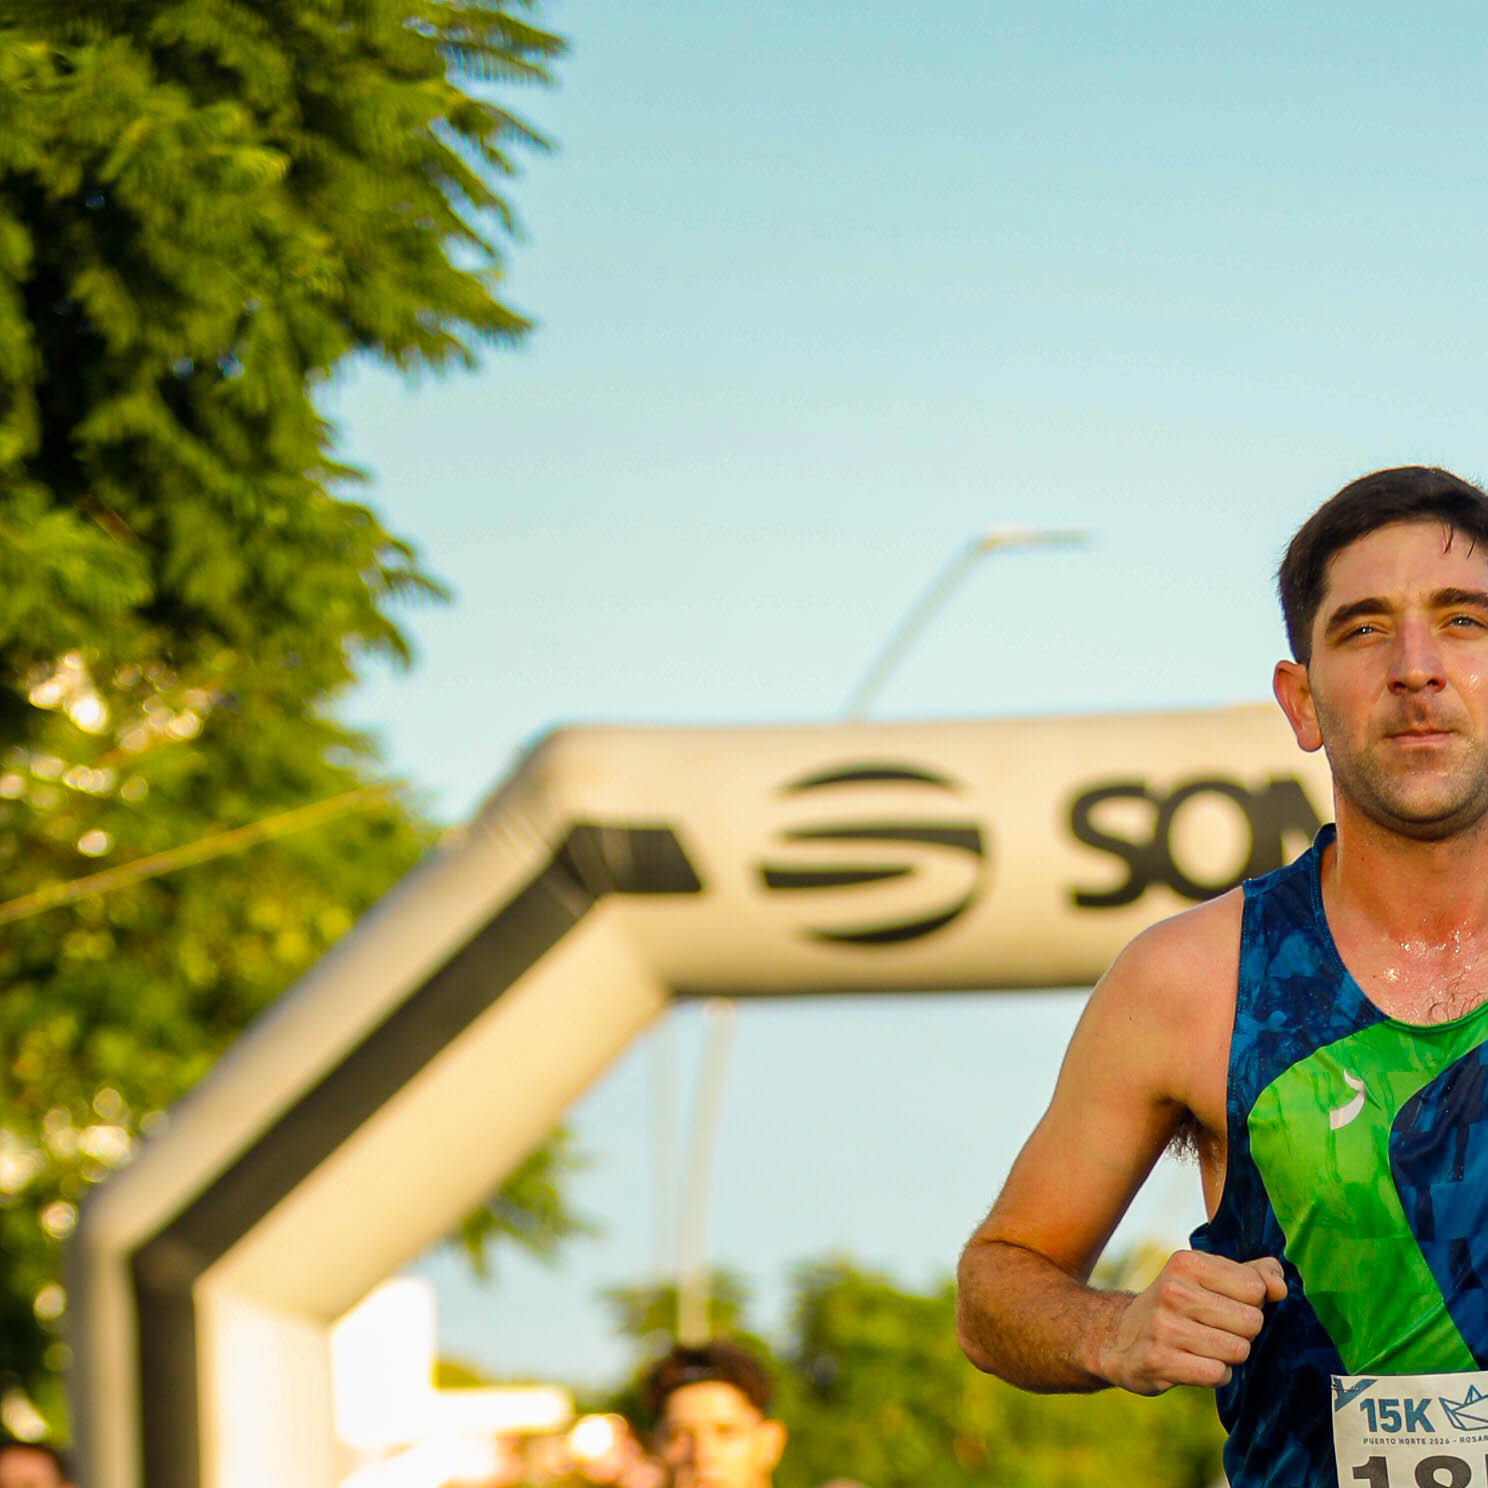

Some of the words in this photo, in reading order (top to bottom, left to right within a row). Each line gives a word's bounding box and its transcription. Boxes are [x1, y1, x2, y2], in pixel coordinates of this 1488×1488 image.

[1360, 1398, 1436, 1433] 15K
[1363, 1437, 1396, 1445] PUERTO
[1399, 1437, 1426, 1445] NORTE
[1429, 1437, 1450, 1445] 2026
